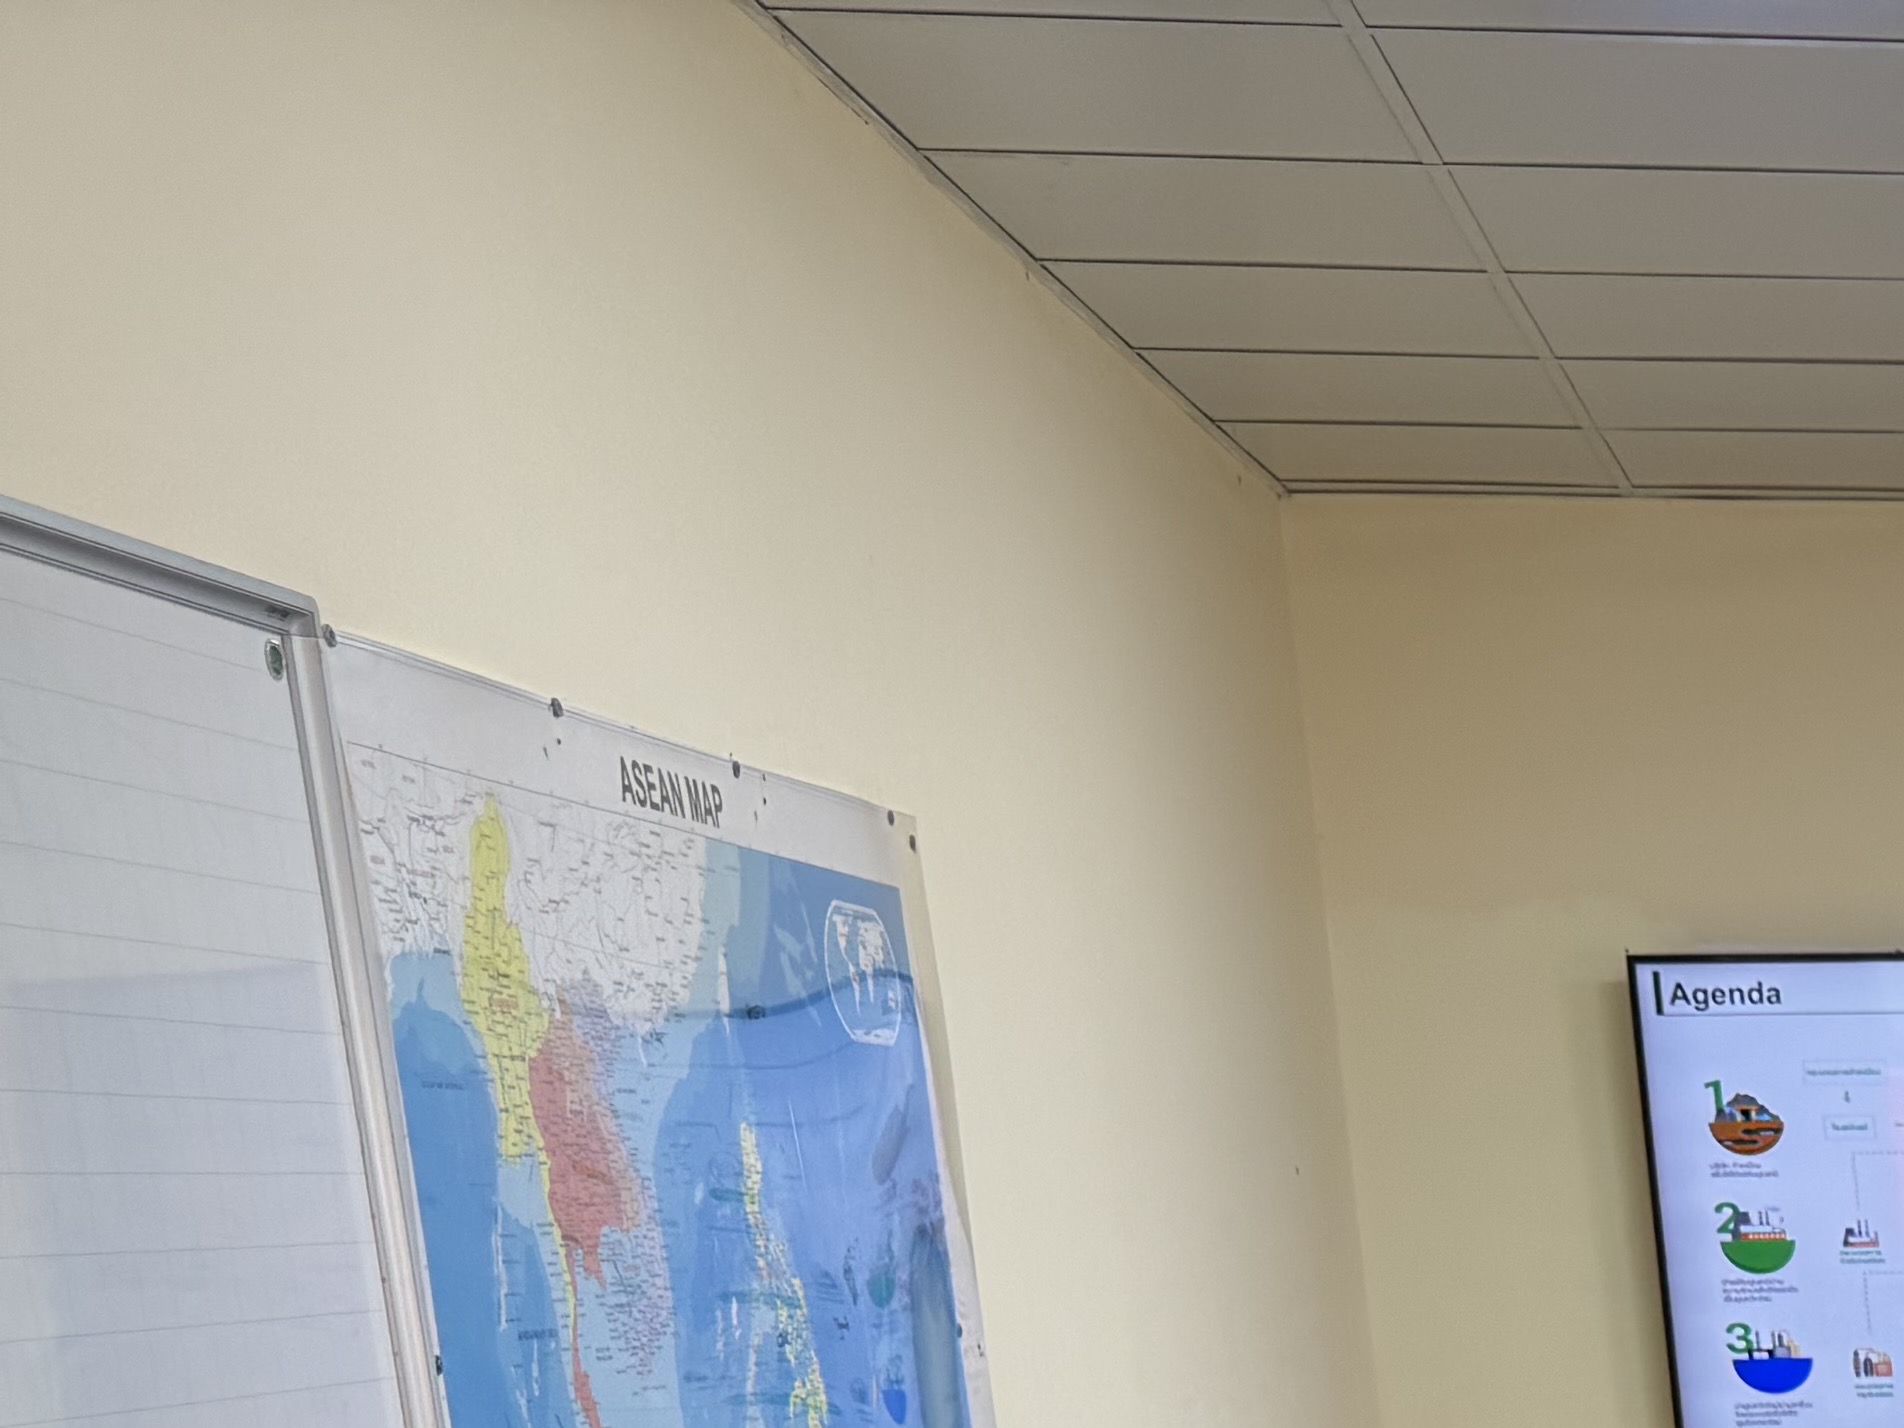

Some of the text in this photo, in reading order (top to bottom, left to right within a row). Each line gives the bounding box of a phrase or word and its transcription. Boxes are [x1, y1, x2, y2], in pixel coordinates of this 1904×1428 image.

[620, 756, 722, 828] ASEAN MAP
[1669, 981, 1782, 1011] Agenda
[1704, 1080, 1724, 1112] 1
[1714, 1202, 1741, 1234] 2
[1725, 1323, 1754, 1354] 3
